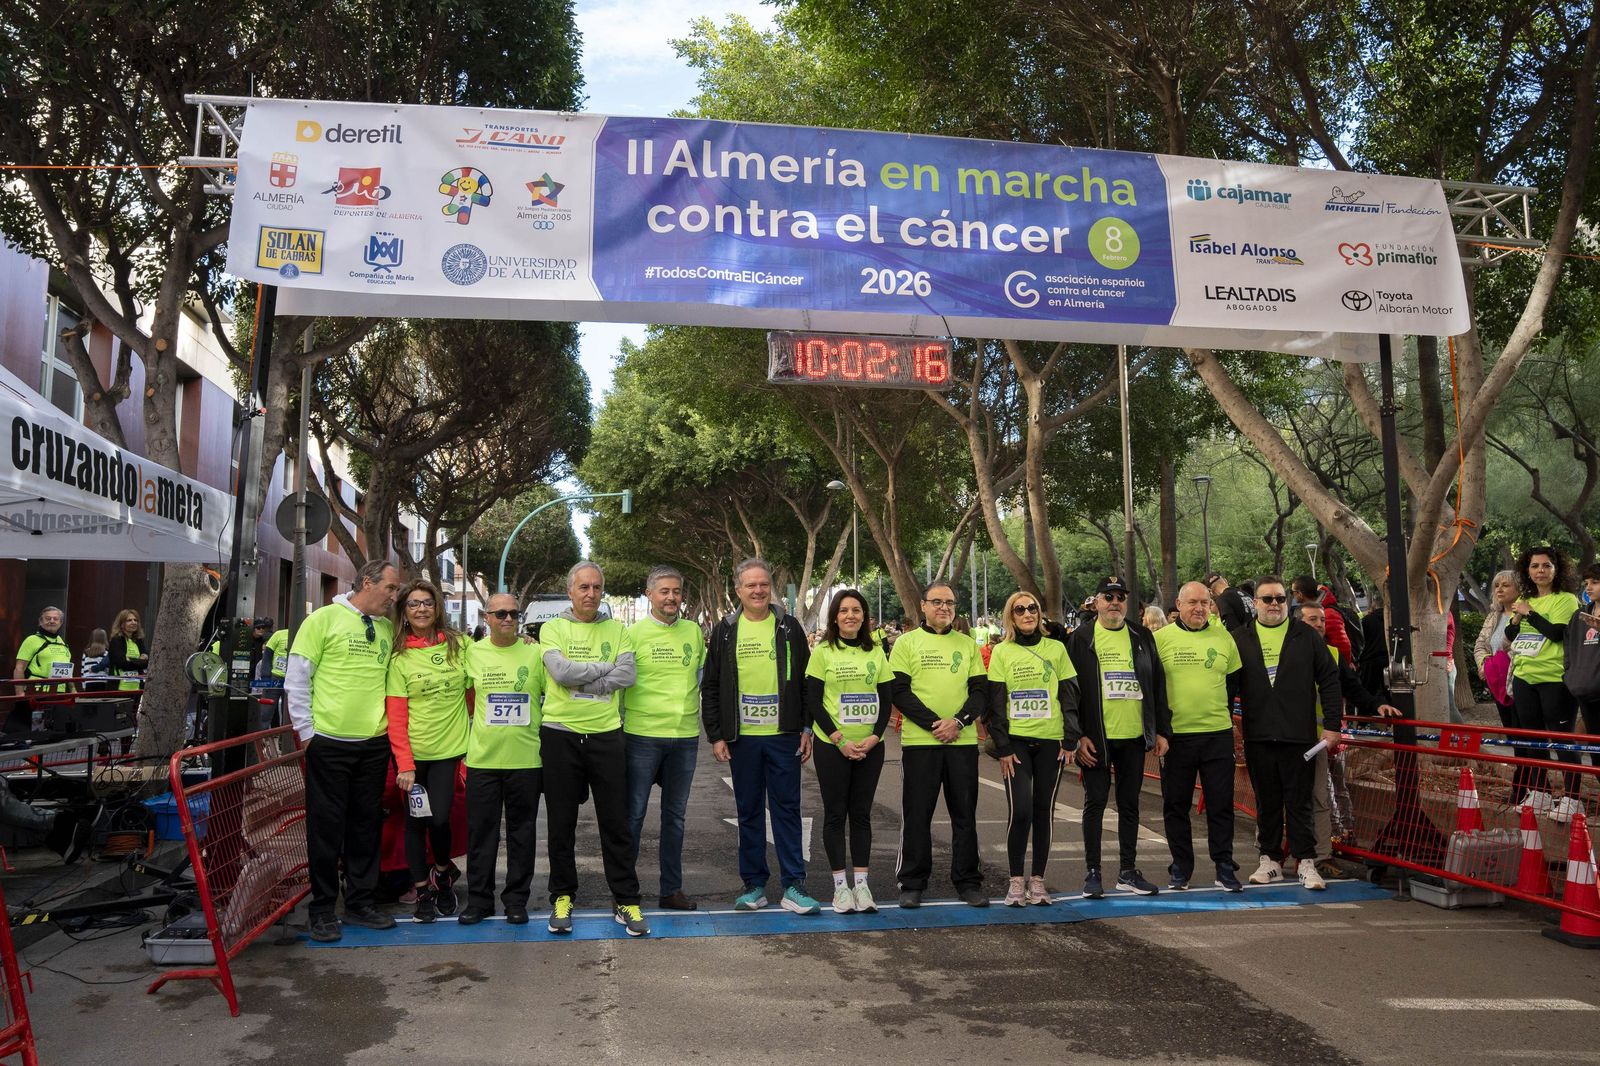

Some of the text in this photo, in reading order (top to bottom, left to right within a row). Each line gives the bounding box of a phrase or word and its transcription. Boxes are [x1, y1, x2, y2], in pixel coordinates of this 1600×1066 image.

[325, 123, 403, 144] deretil
[484, 124, 539, 134] TRANSPORTES
[627, 139, 1138, 207] II Almería en marcha
[252, 191, 305, 204] ALMERÍA
[1217, 184, 1292, 205] cajamar
[266, 203, 294, 211] CIUDAD
[1324, 202, 1442, 216] MICHELIN Fundación
[551, 213, 572, 221] 2005
[647, 199, 1070, 255] contra el cáncer
[1105, 226, 1123, 253] 8
[1189, 240, 1297, 260] Isabel Alonso
[1375, 242, 1436, 253] FUNDACIÓN
[265, 248, 317, 263] DE CABRAS
[488, 255, 578, 269] UNIVERSIDAD
[1377, 251, 1438, 266] primaflor
[488, 266, 508, 278] DE
[645, 265, 804, 287] #TodosContraElCáncer
[860, 267, 932, 298] 2026
[1044, 274, 1145, 289] asociación española
[1047, 286, 1126, 299] contra el cáncer
[1204, 285, 1297, 303] LEALTADIS
[1375, 290, 1413, 303] Toyota
[1048, 298, 1105, 309] en Almería
[1226, 303, 1278, 312] ABOGADOS
[1378, 303, 1453, 315] Alborán Motor
[54, 668, 70, 676] 743
[1106, 681, 1141, 693] 1729
[493, 704, 522, 717] 571
[742, 704, 778, 718] 1253
[842, 704, 877, 717] 1800
[1013, 700, 1049, 712] 1402
